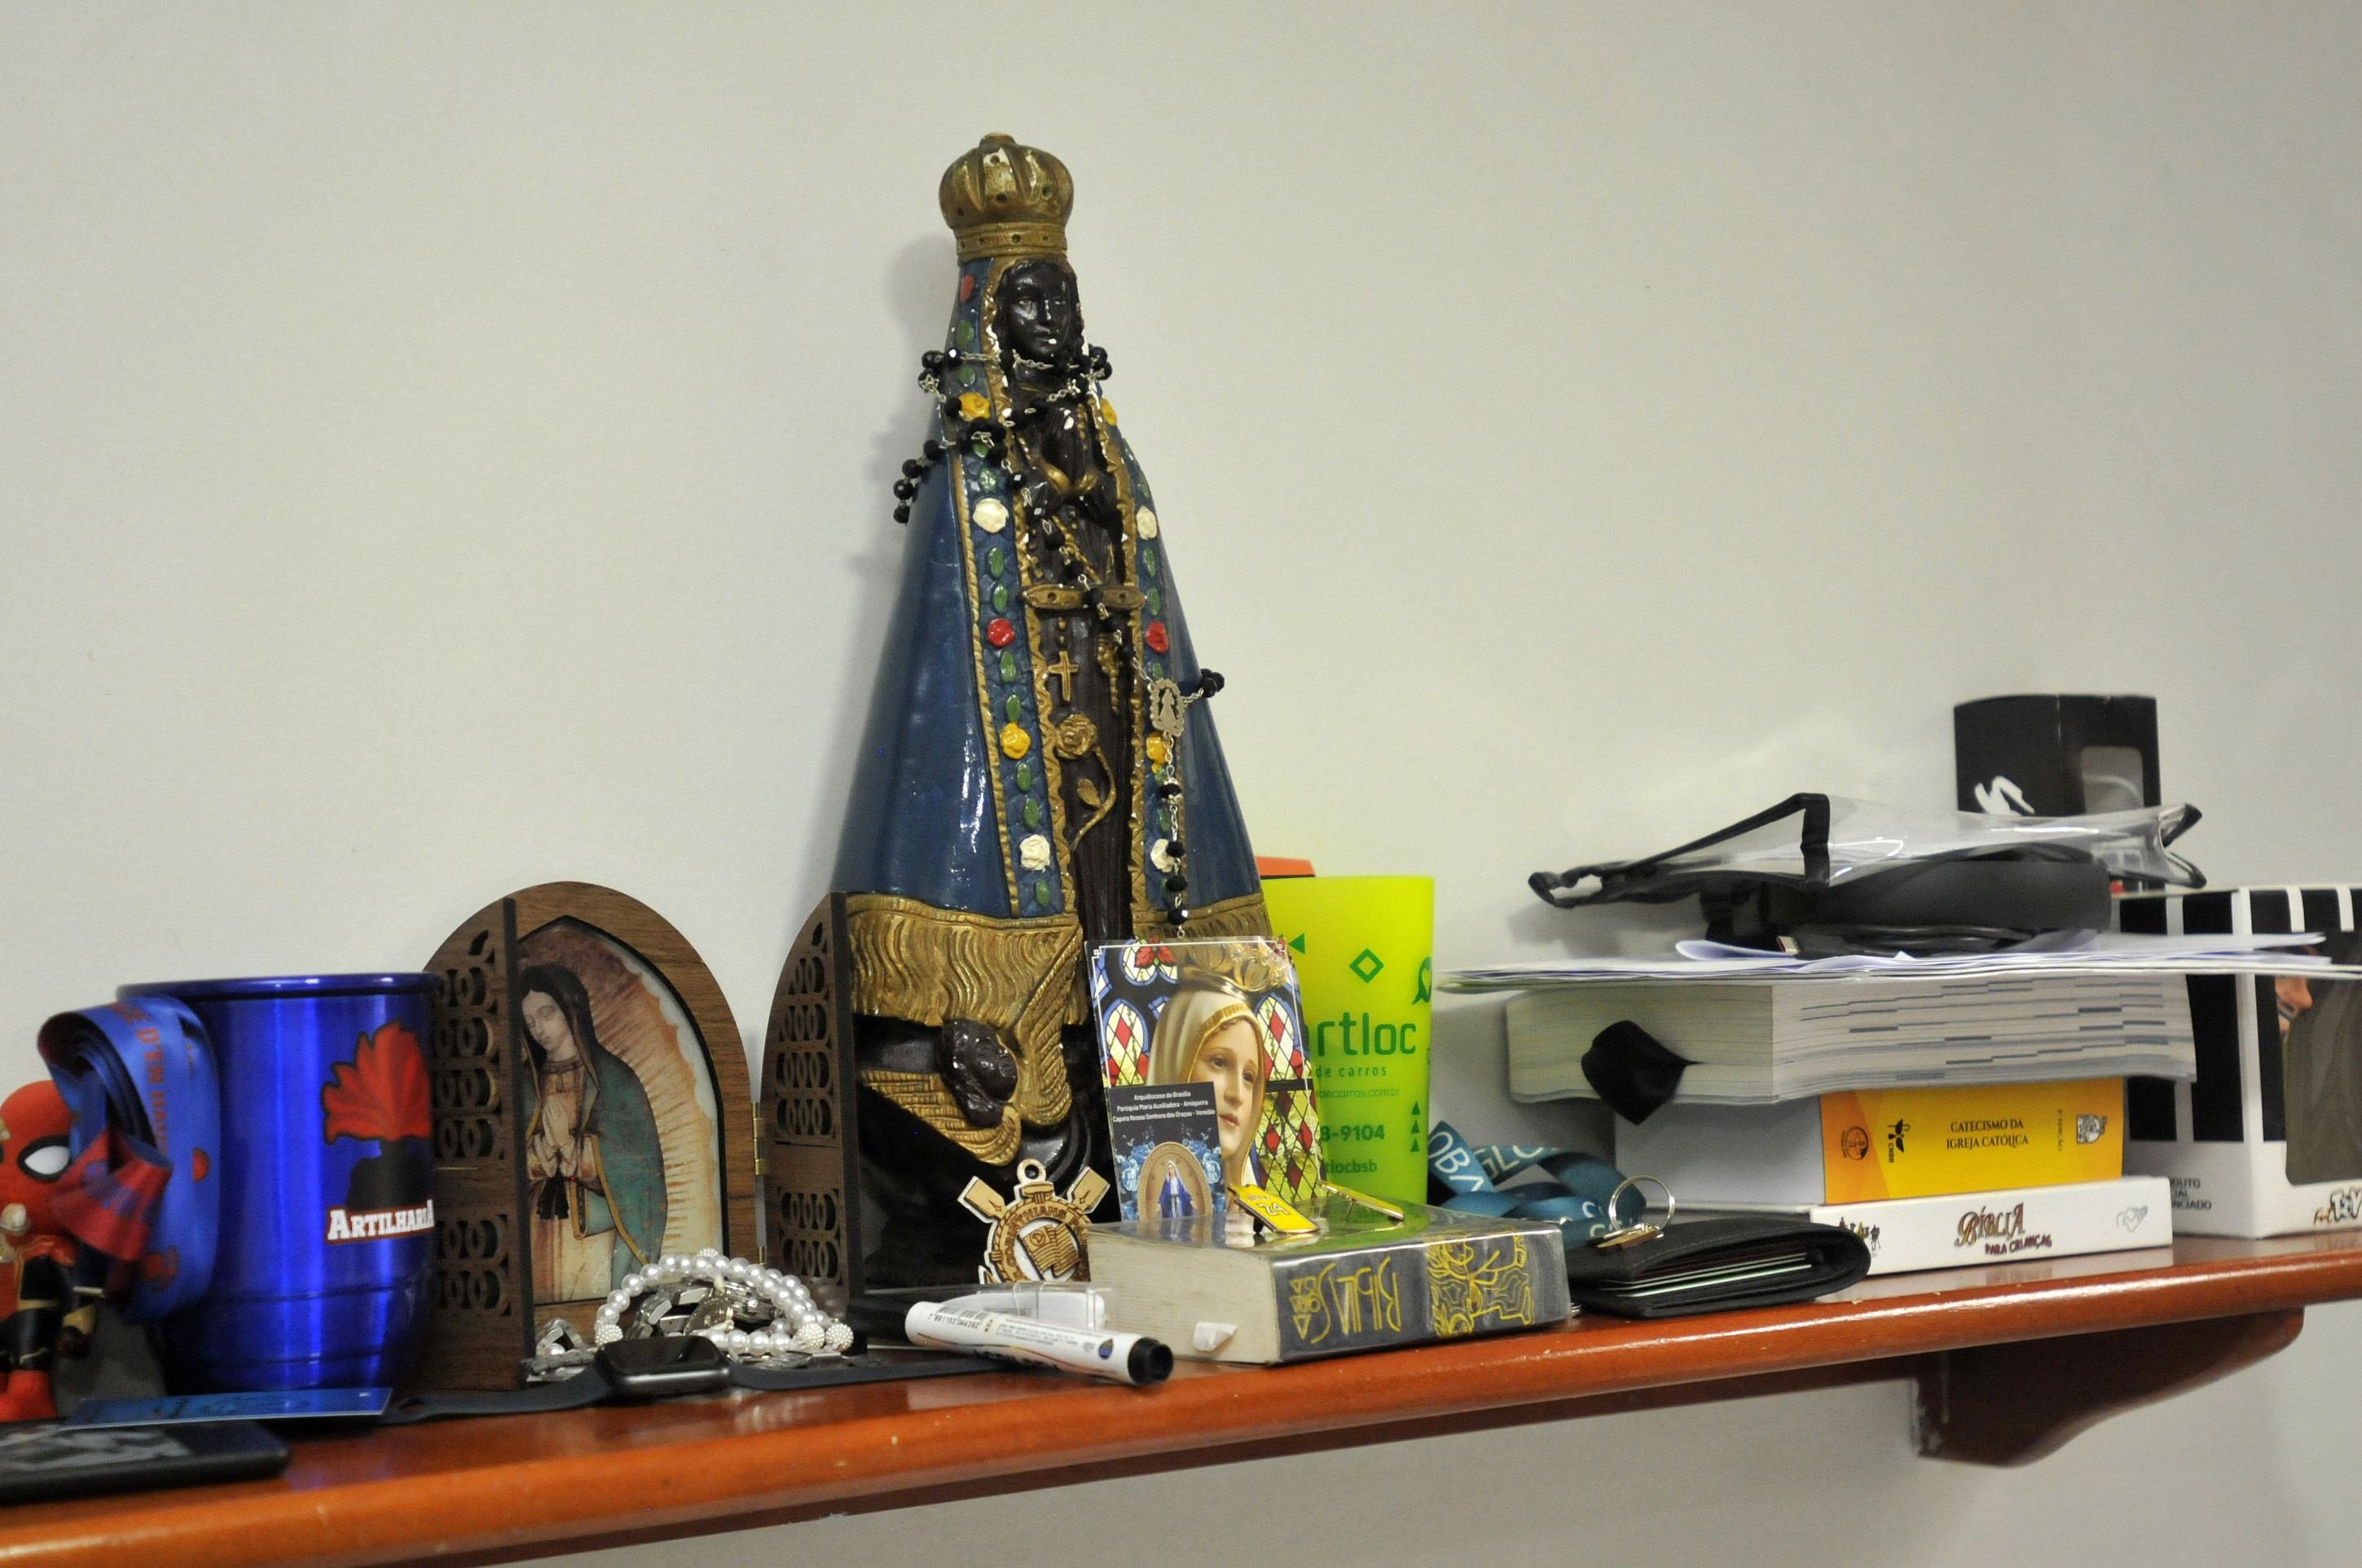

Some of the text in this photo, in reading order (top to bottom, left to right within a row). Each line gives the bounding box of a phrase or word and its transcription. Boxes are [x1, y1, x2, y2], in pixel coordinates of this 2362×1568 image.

[1304, 1012, 1417, 1057] rtloc
[1316, 1065, 1387, 1078] de carros
[1317, 1087, 1400, 1099] decarros.com.br
[1951, 1118, 2024, 1133] CATECISMO DA
[1946, 1133, 2028, 1150] IGREJA CATÓLICA
[1259, 1201, 1291, 1216] 24
[1985, 1242, 2007, 1255] PARA
